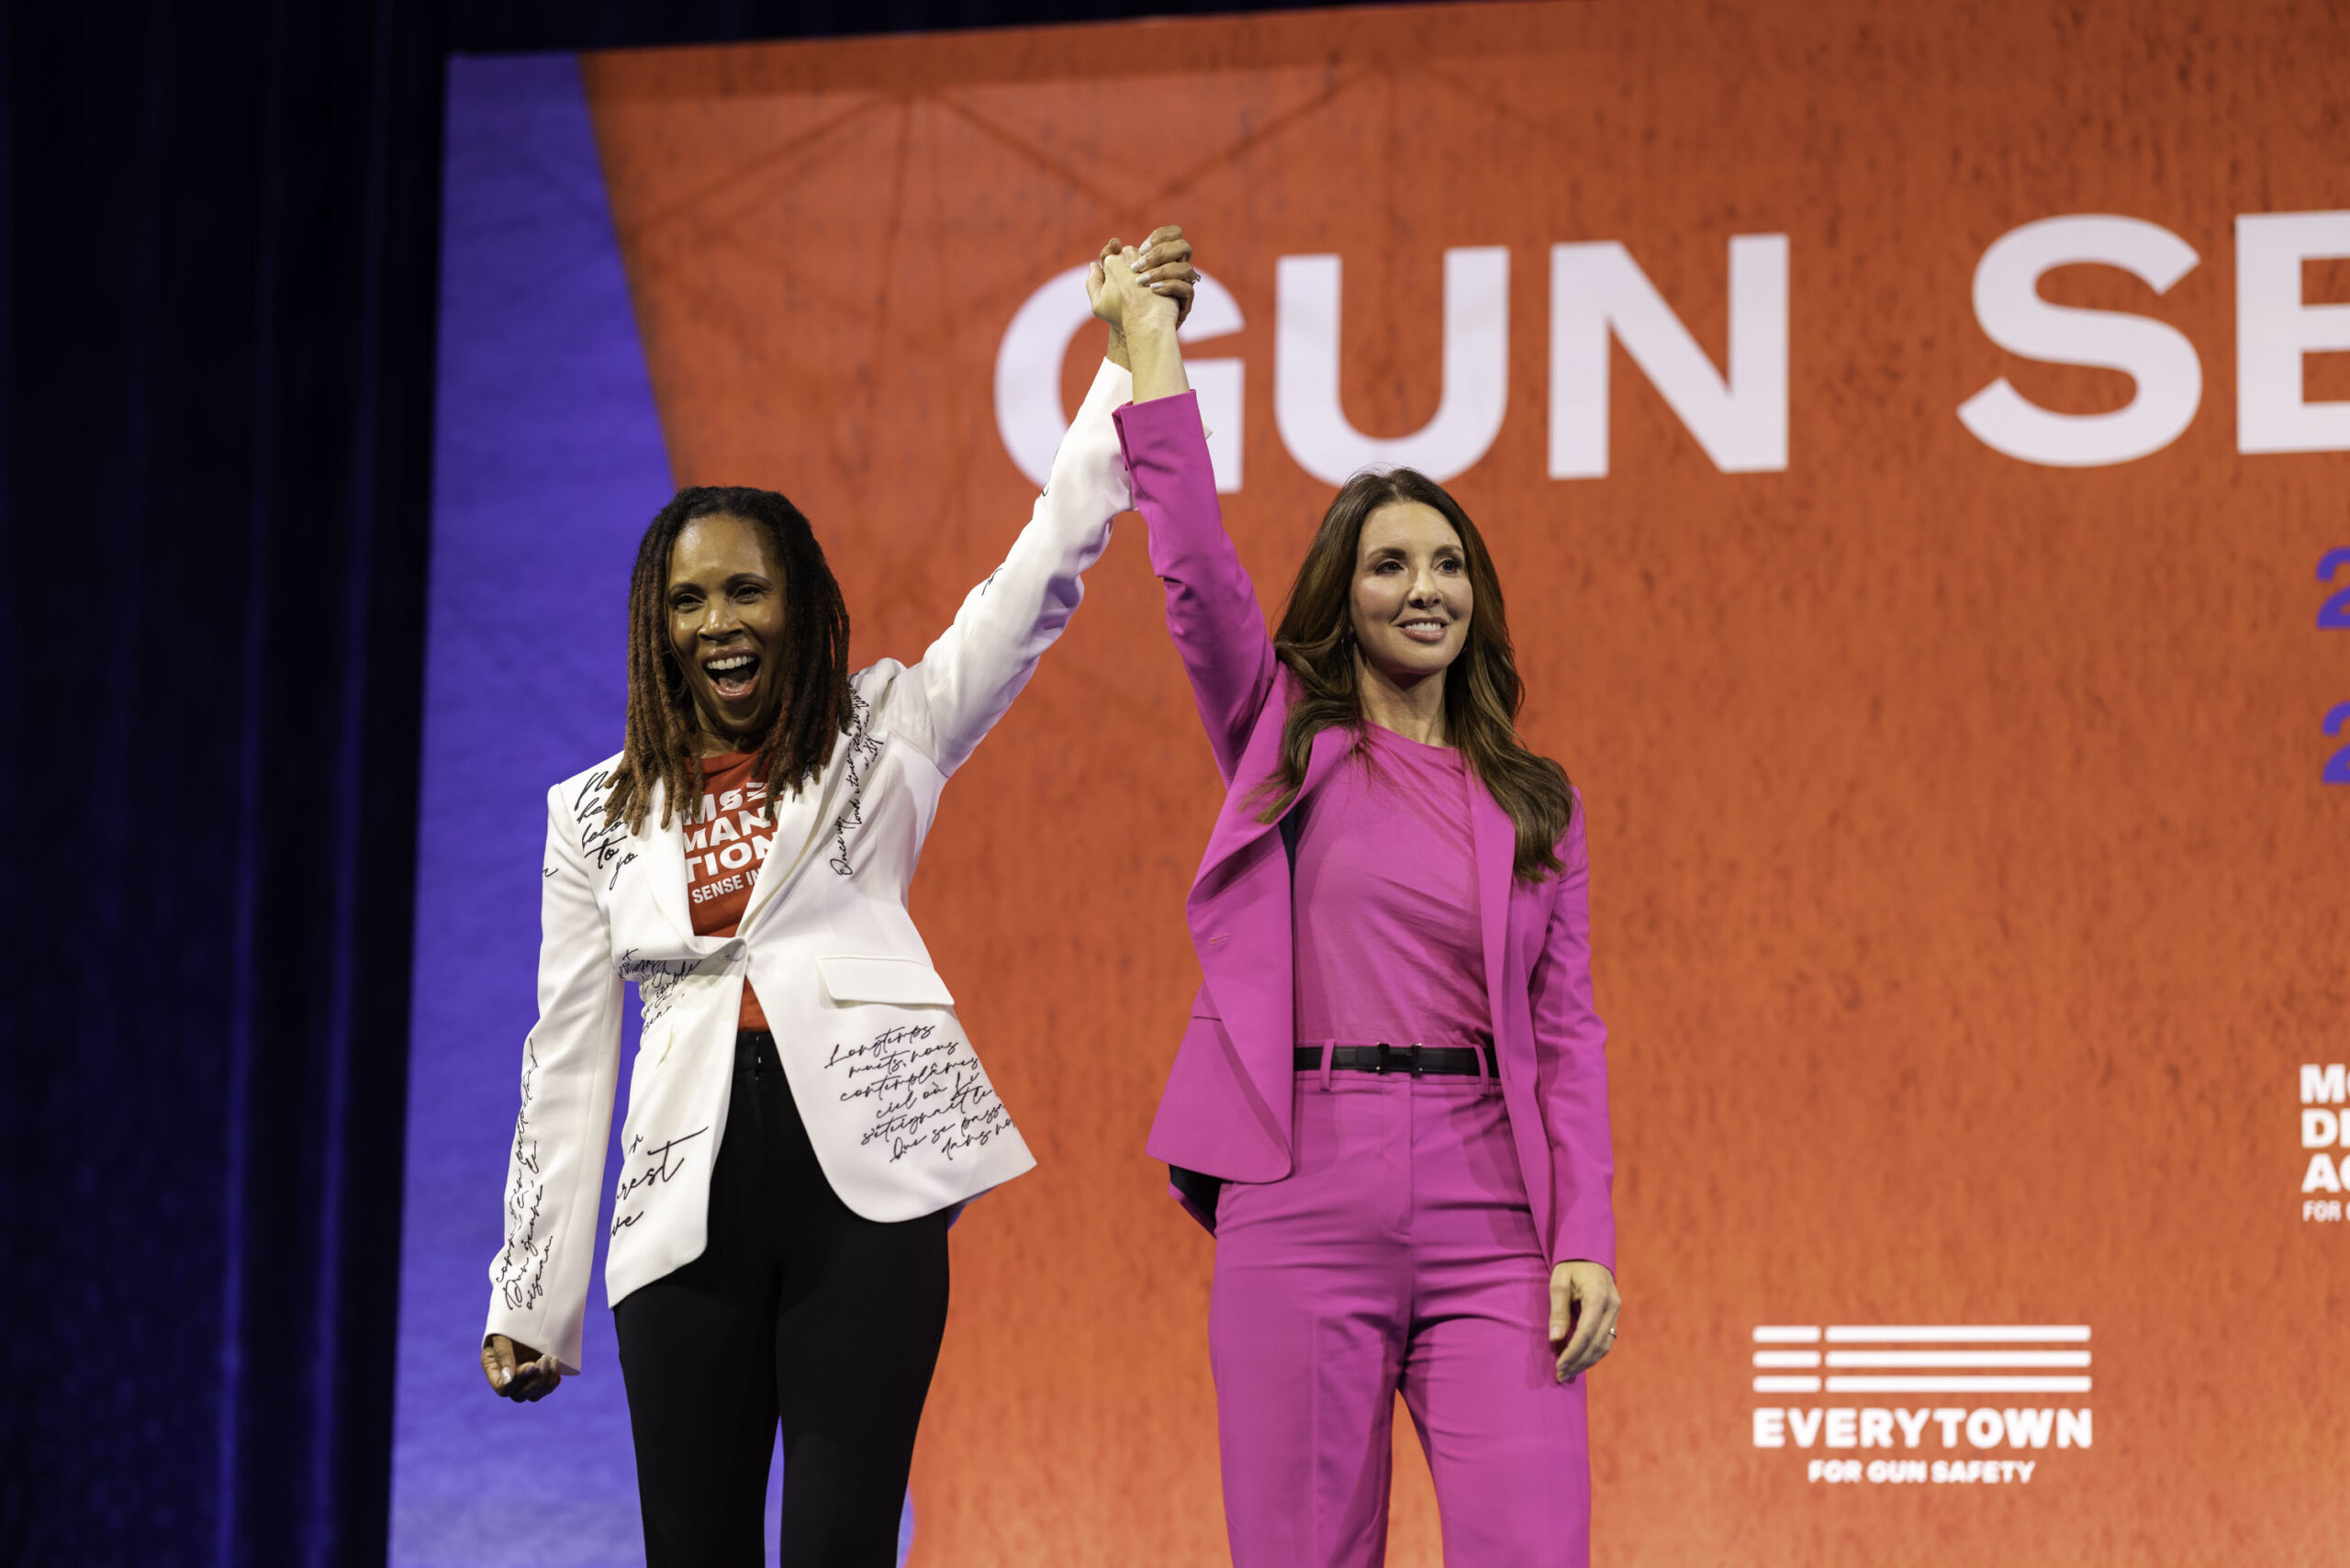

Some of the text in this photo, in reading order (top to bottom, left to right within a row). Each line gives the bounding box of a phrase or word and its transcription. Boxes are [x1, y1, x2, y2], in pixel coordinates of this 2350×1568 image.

[994, 233, 1790, 493] GUN
[691, 874, 744, 904] SENSE
[824, 1025, 936, 1070] Longtemps
[1752, 1407, 2093, 1449] EVERYTOWN
[1807, 1460, 2036, 1484] FOR GUN SAFETY
